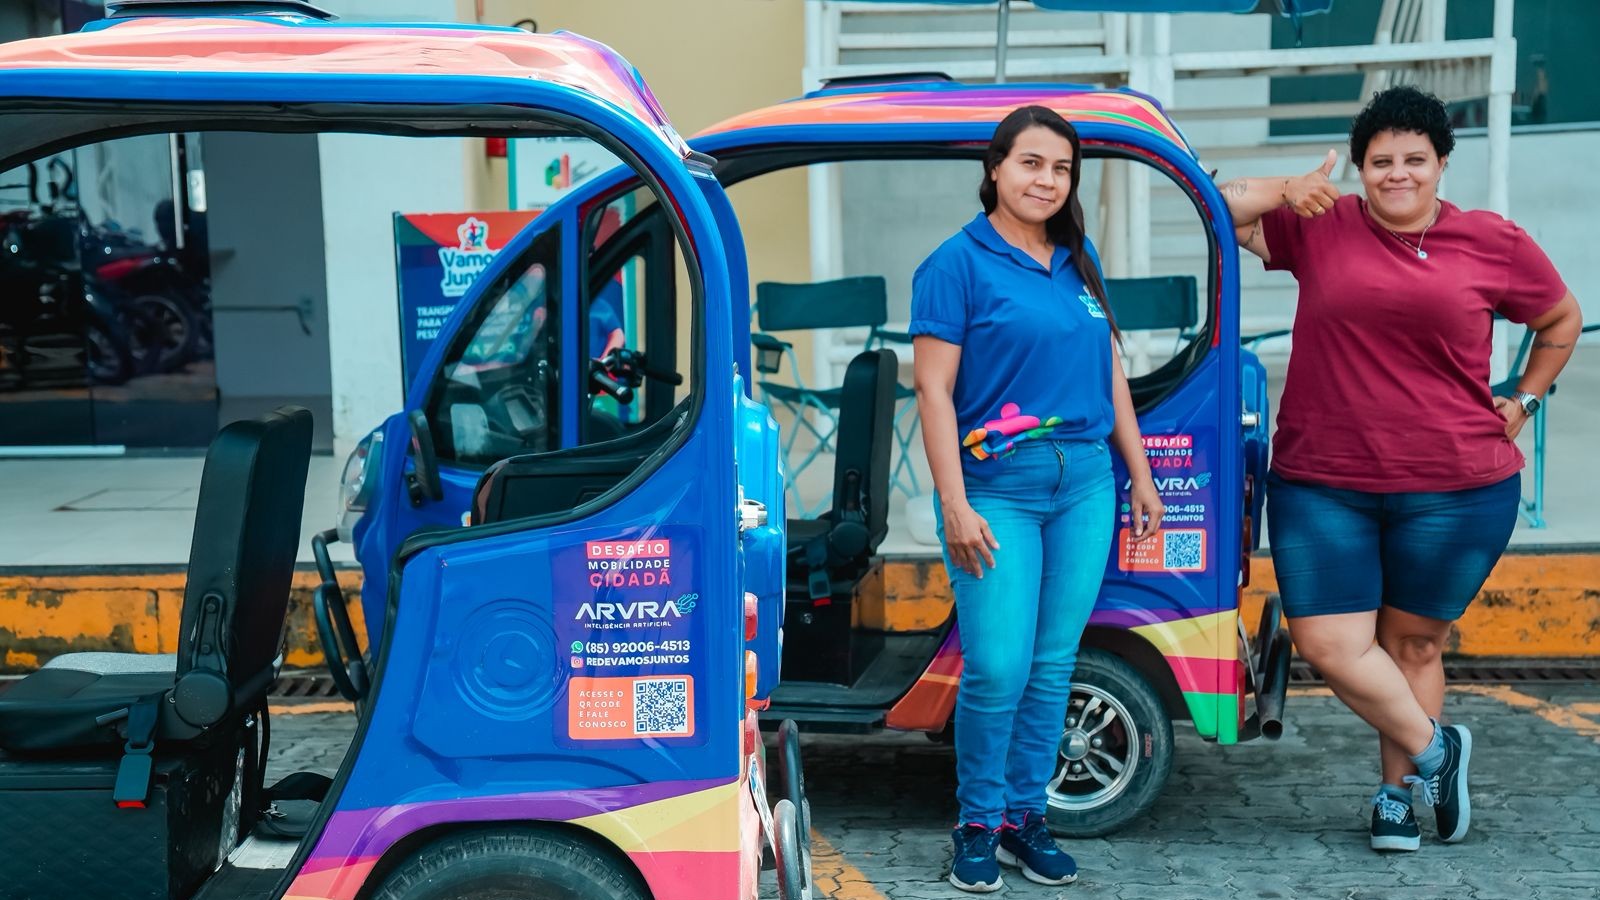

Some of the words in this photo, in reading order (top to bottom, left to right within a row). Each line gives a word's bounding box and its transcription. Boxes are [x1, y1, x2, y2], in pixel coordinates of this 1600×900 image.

[442, 251, 493, 268] Vamo
[1144, 448, 1193, 456] OBILIDADE
[1151, 455, 1192, 468] DADÃ
[592, 543, 665, 556] DESAFIO
[588, 559, 670, 570] MOBILIDADE
[589, 568, 671, 588] CIDADÃ
[575, 600, 682, 620] ARVRA
[584, 621, 631, 629] INTELIGÊNCIA
[633, 620, 672, 628] ARTIFICIAL
[585, 641, 609, 654] (85)
[612, 640, 691, 653] 92006-4513
[586, 654, 690, 666] REDEVAMOSJUNTOS
[579, 690, 614, 698] ACESSE
[617, 690, 624, 698] O
[594, 700, 621, 708] CODE
[579, 720, 627, 728] CONOSCO
